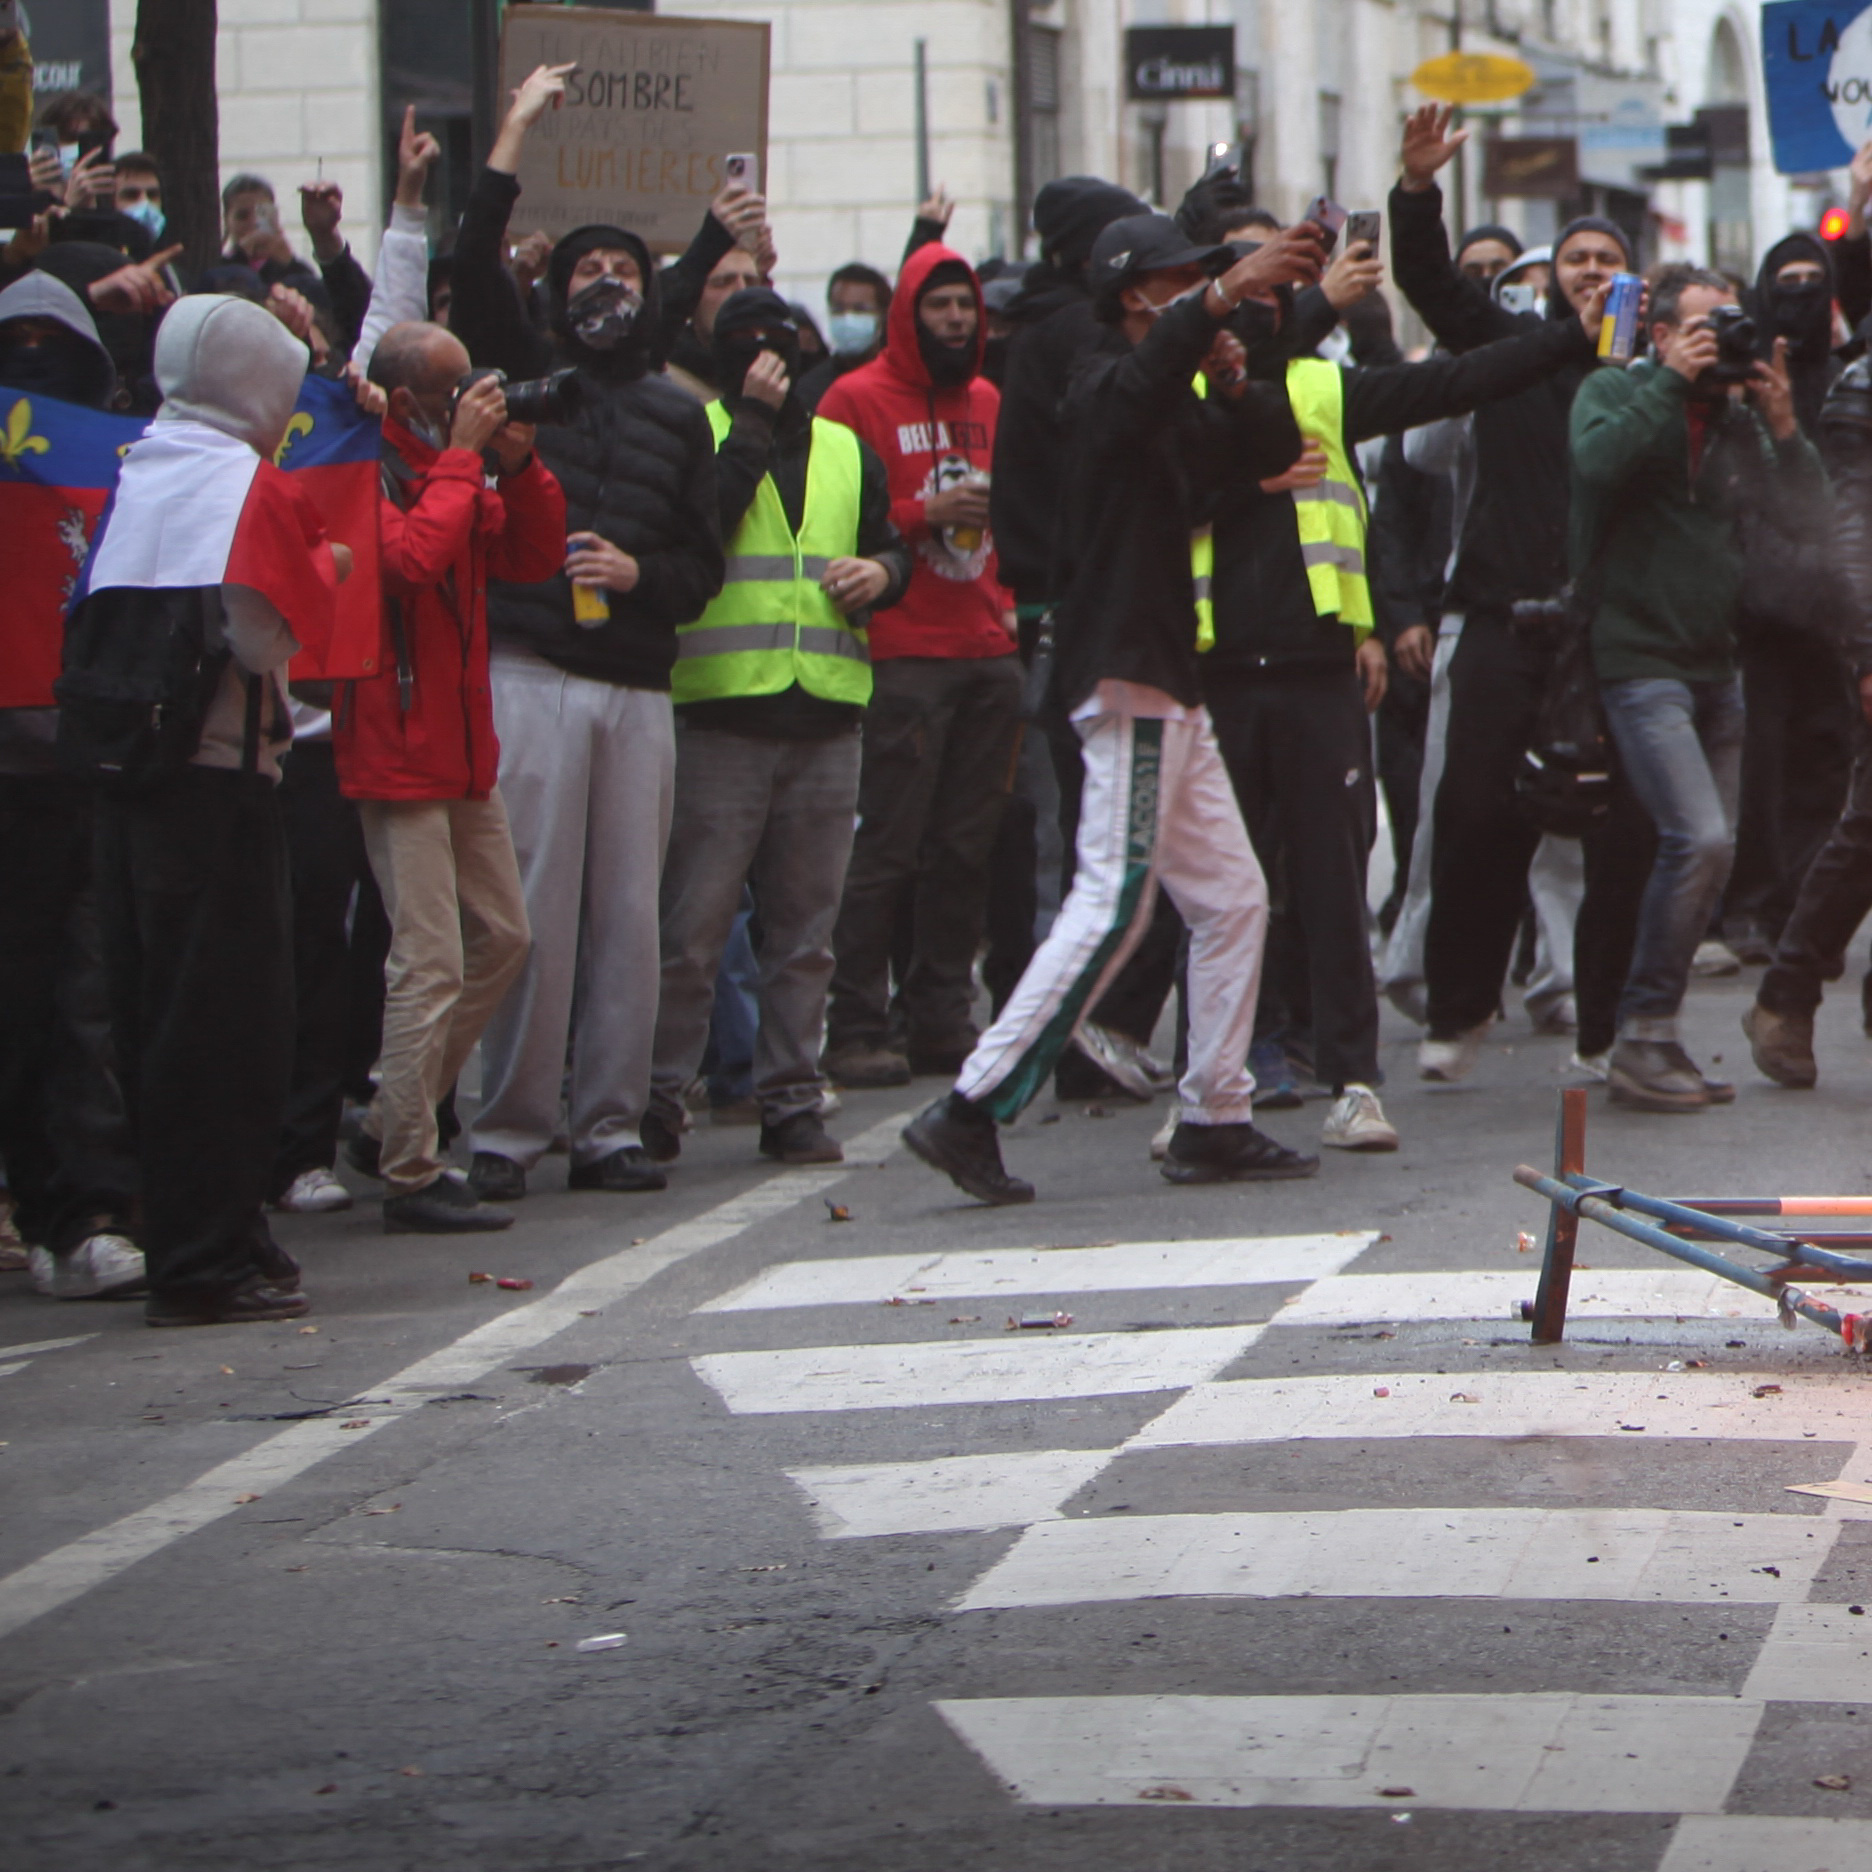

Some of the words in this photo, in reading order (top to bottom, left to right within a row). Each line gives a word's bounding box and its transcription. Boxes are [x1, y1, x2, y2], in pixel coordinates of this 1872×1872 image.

[649, 36, 721, 73] BIEN
[1788, 17, 1840, 62] LA
[566, 67, 694, 112] SOMBRE
[557, 145, 722, 196] LUMIERES
